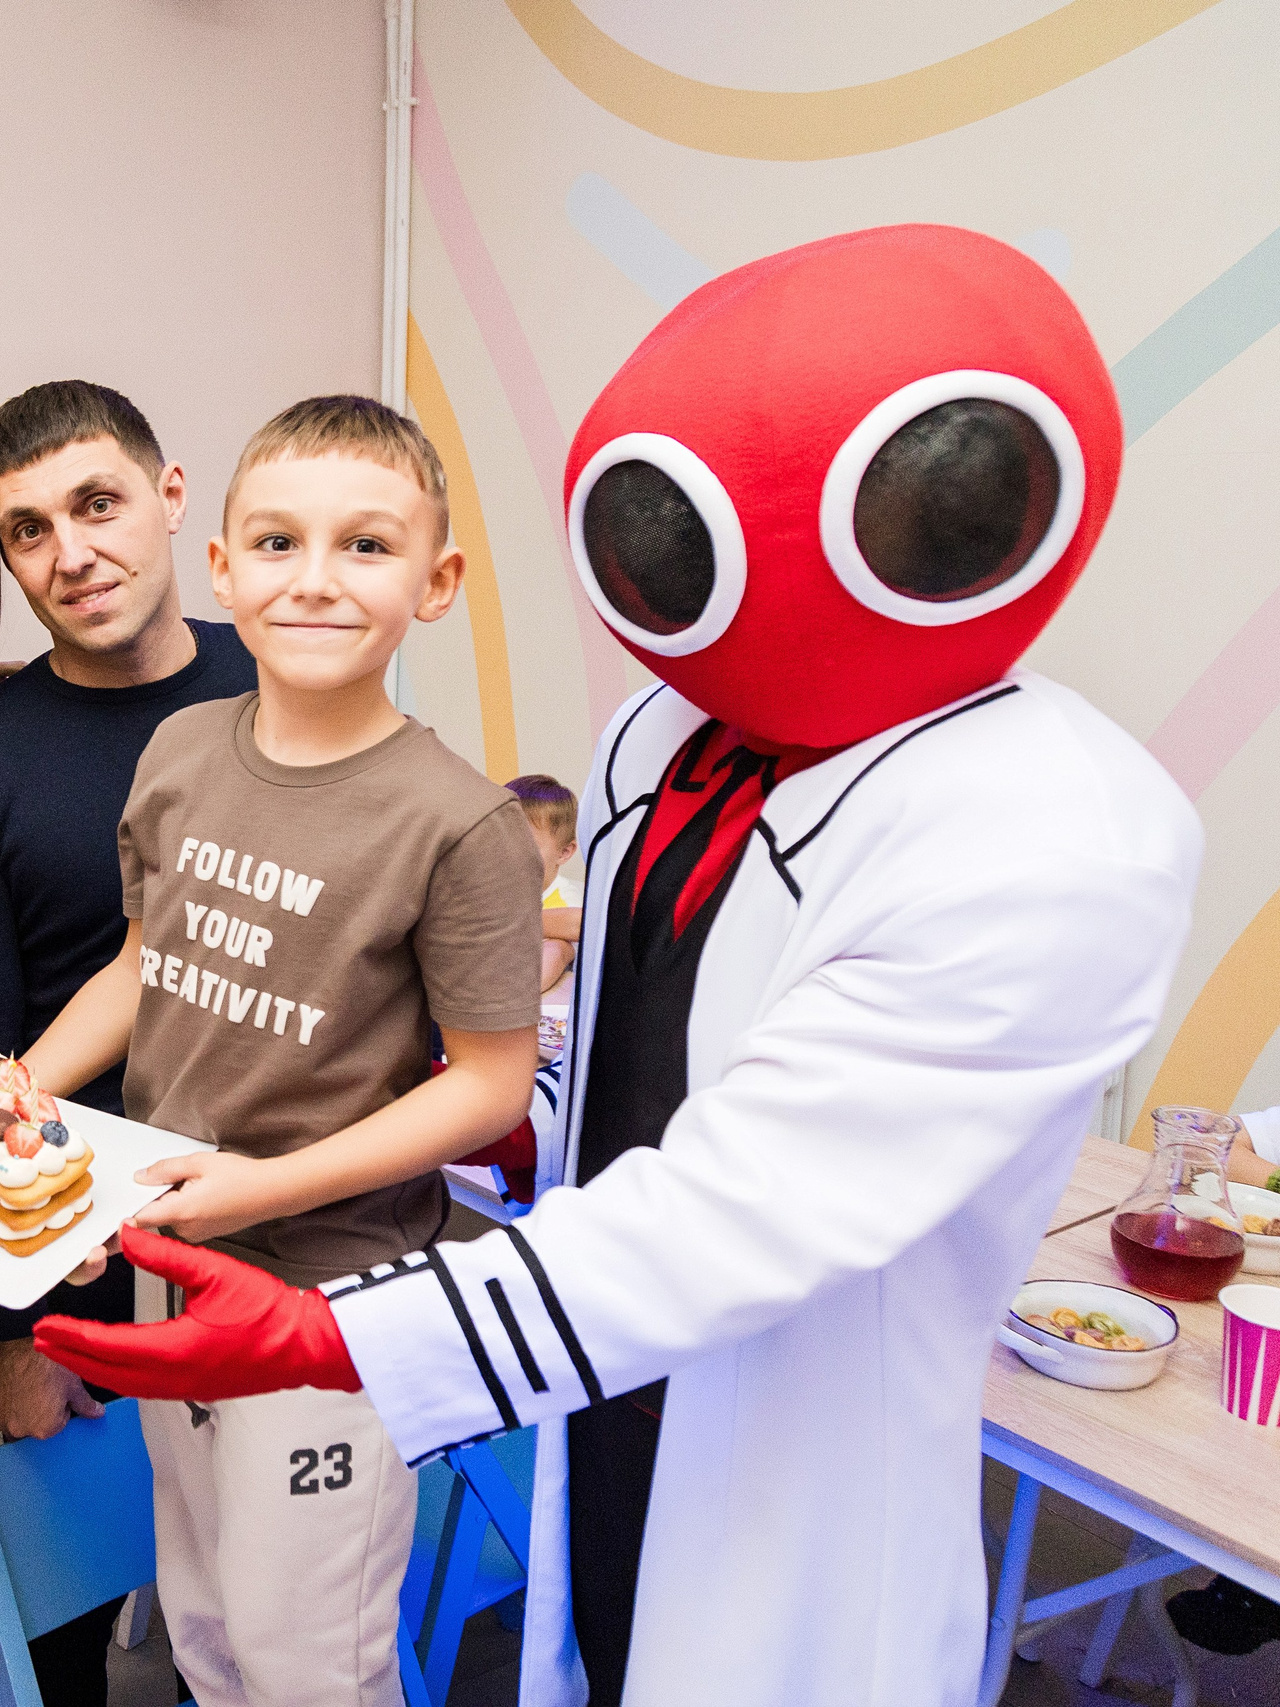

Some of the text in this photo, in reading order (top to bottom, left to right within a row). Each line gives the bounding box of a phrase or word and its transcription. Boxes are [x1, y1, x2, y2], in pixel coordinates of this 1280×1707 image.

[176, 837, 325, 917] FOLLOW
[185, 901, 274, 967] YOUR
[290, 1442, 352, 1495] 23
